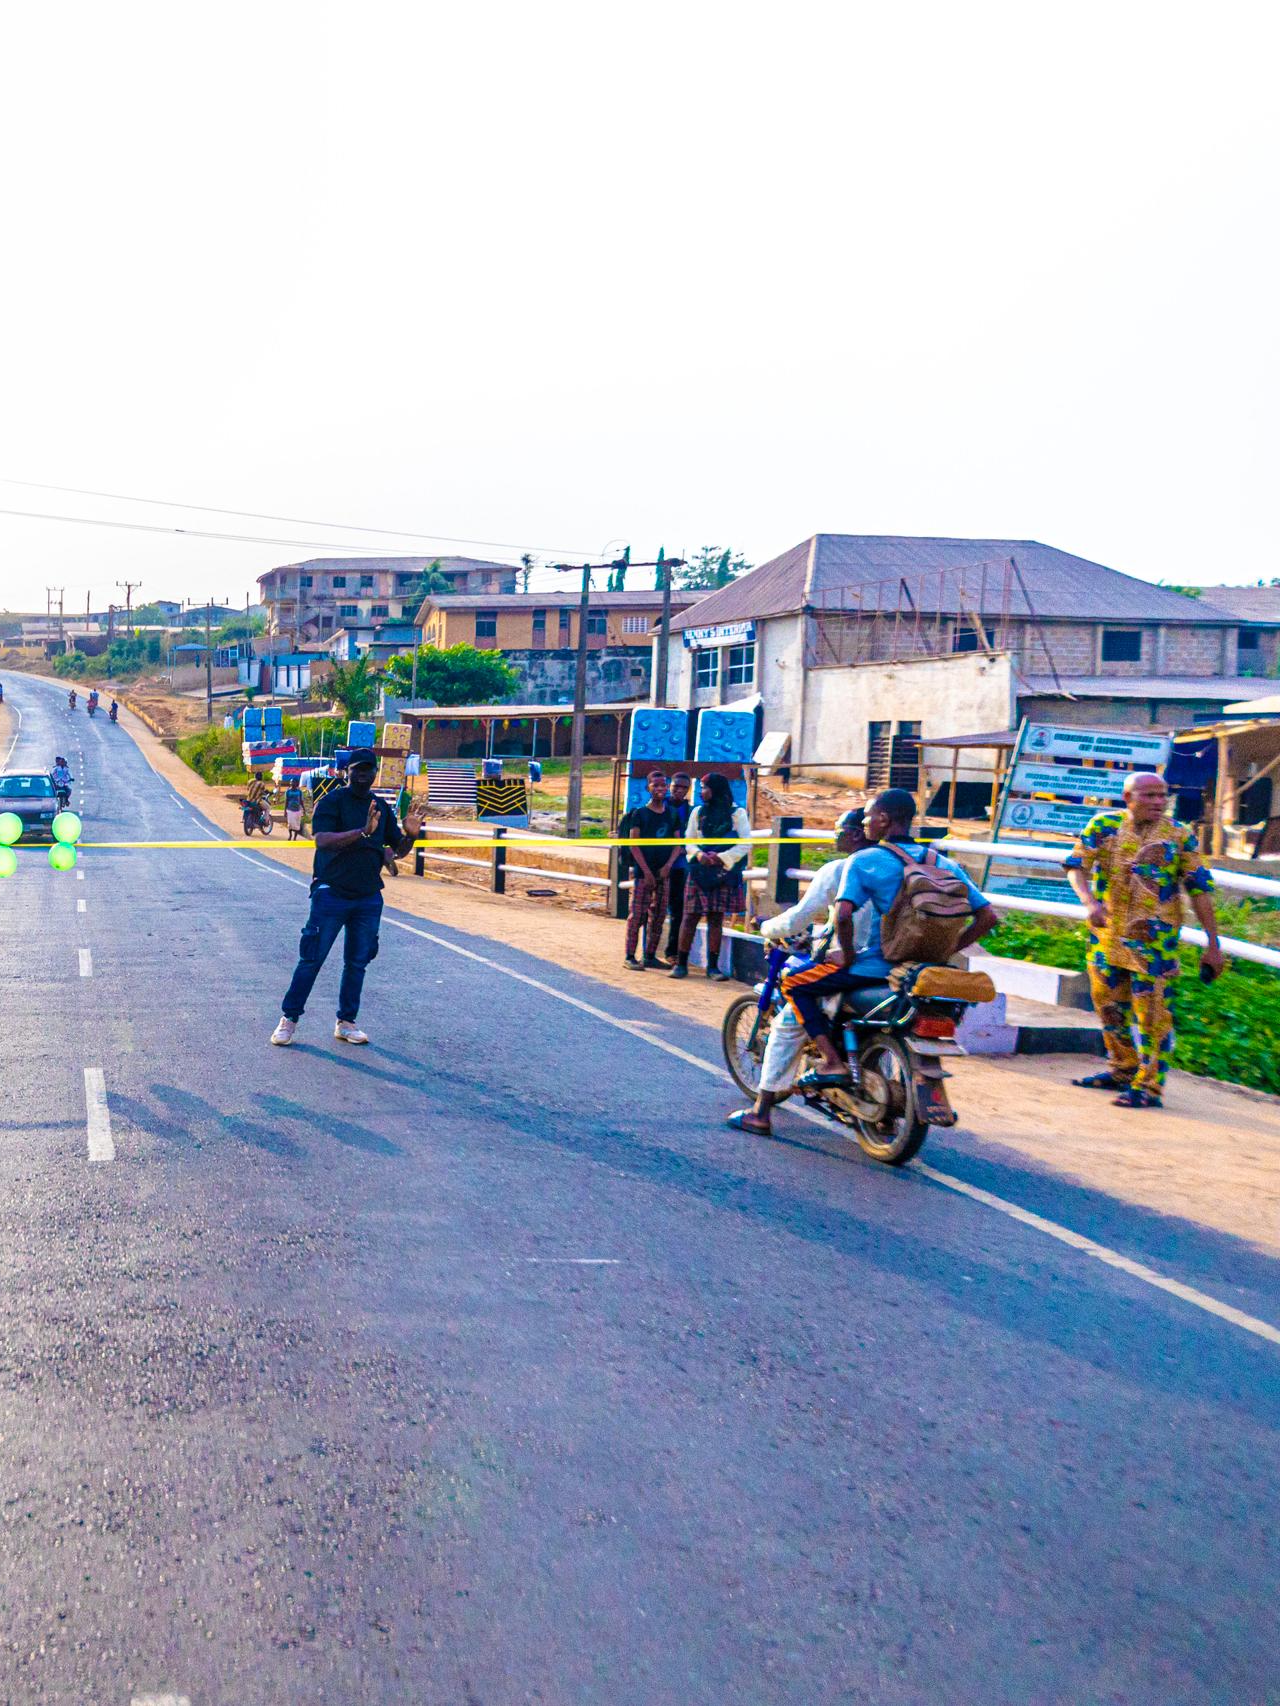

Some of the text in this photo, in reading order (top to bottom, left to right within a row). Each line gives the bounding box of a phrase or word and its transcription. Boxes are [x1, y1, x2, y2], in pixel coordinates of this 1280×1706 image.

[1054, 733, 1161, 749] FEDERAL GOVERNMENT
[1079, 743, 1132, 755] OF NIGERIA
